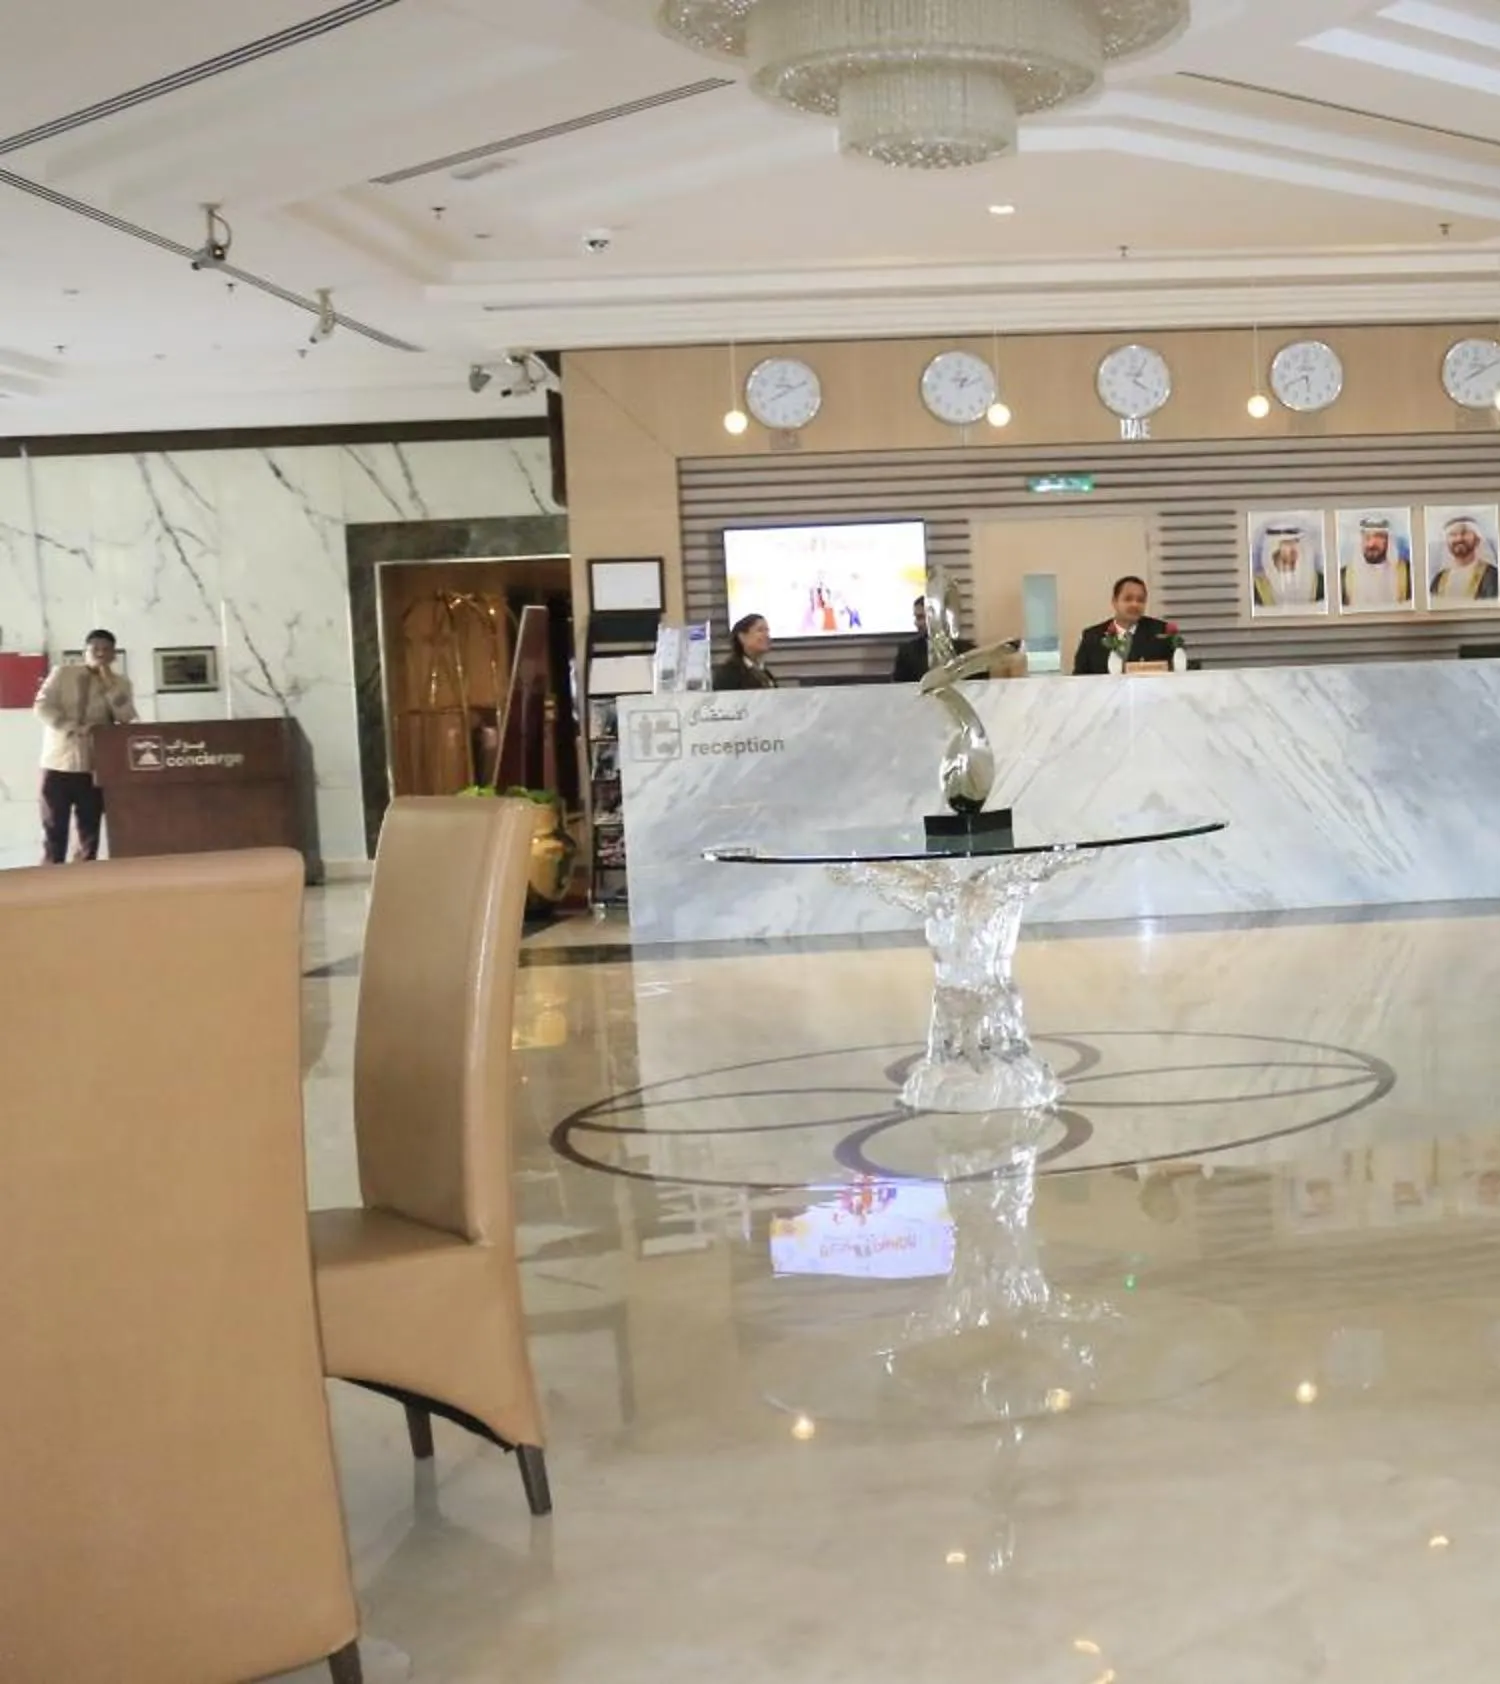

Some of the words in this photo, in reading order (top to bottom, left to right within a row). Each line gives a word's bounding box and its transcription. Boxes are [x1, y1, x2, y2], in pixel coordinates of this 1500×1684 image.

[1119, 418, 1151, 440] UAE
[690, 737, 785, 759] reception
[165, 751, 245, 768] concierge
